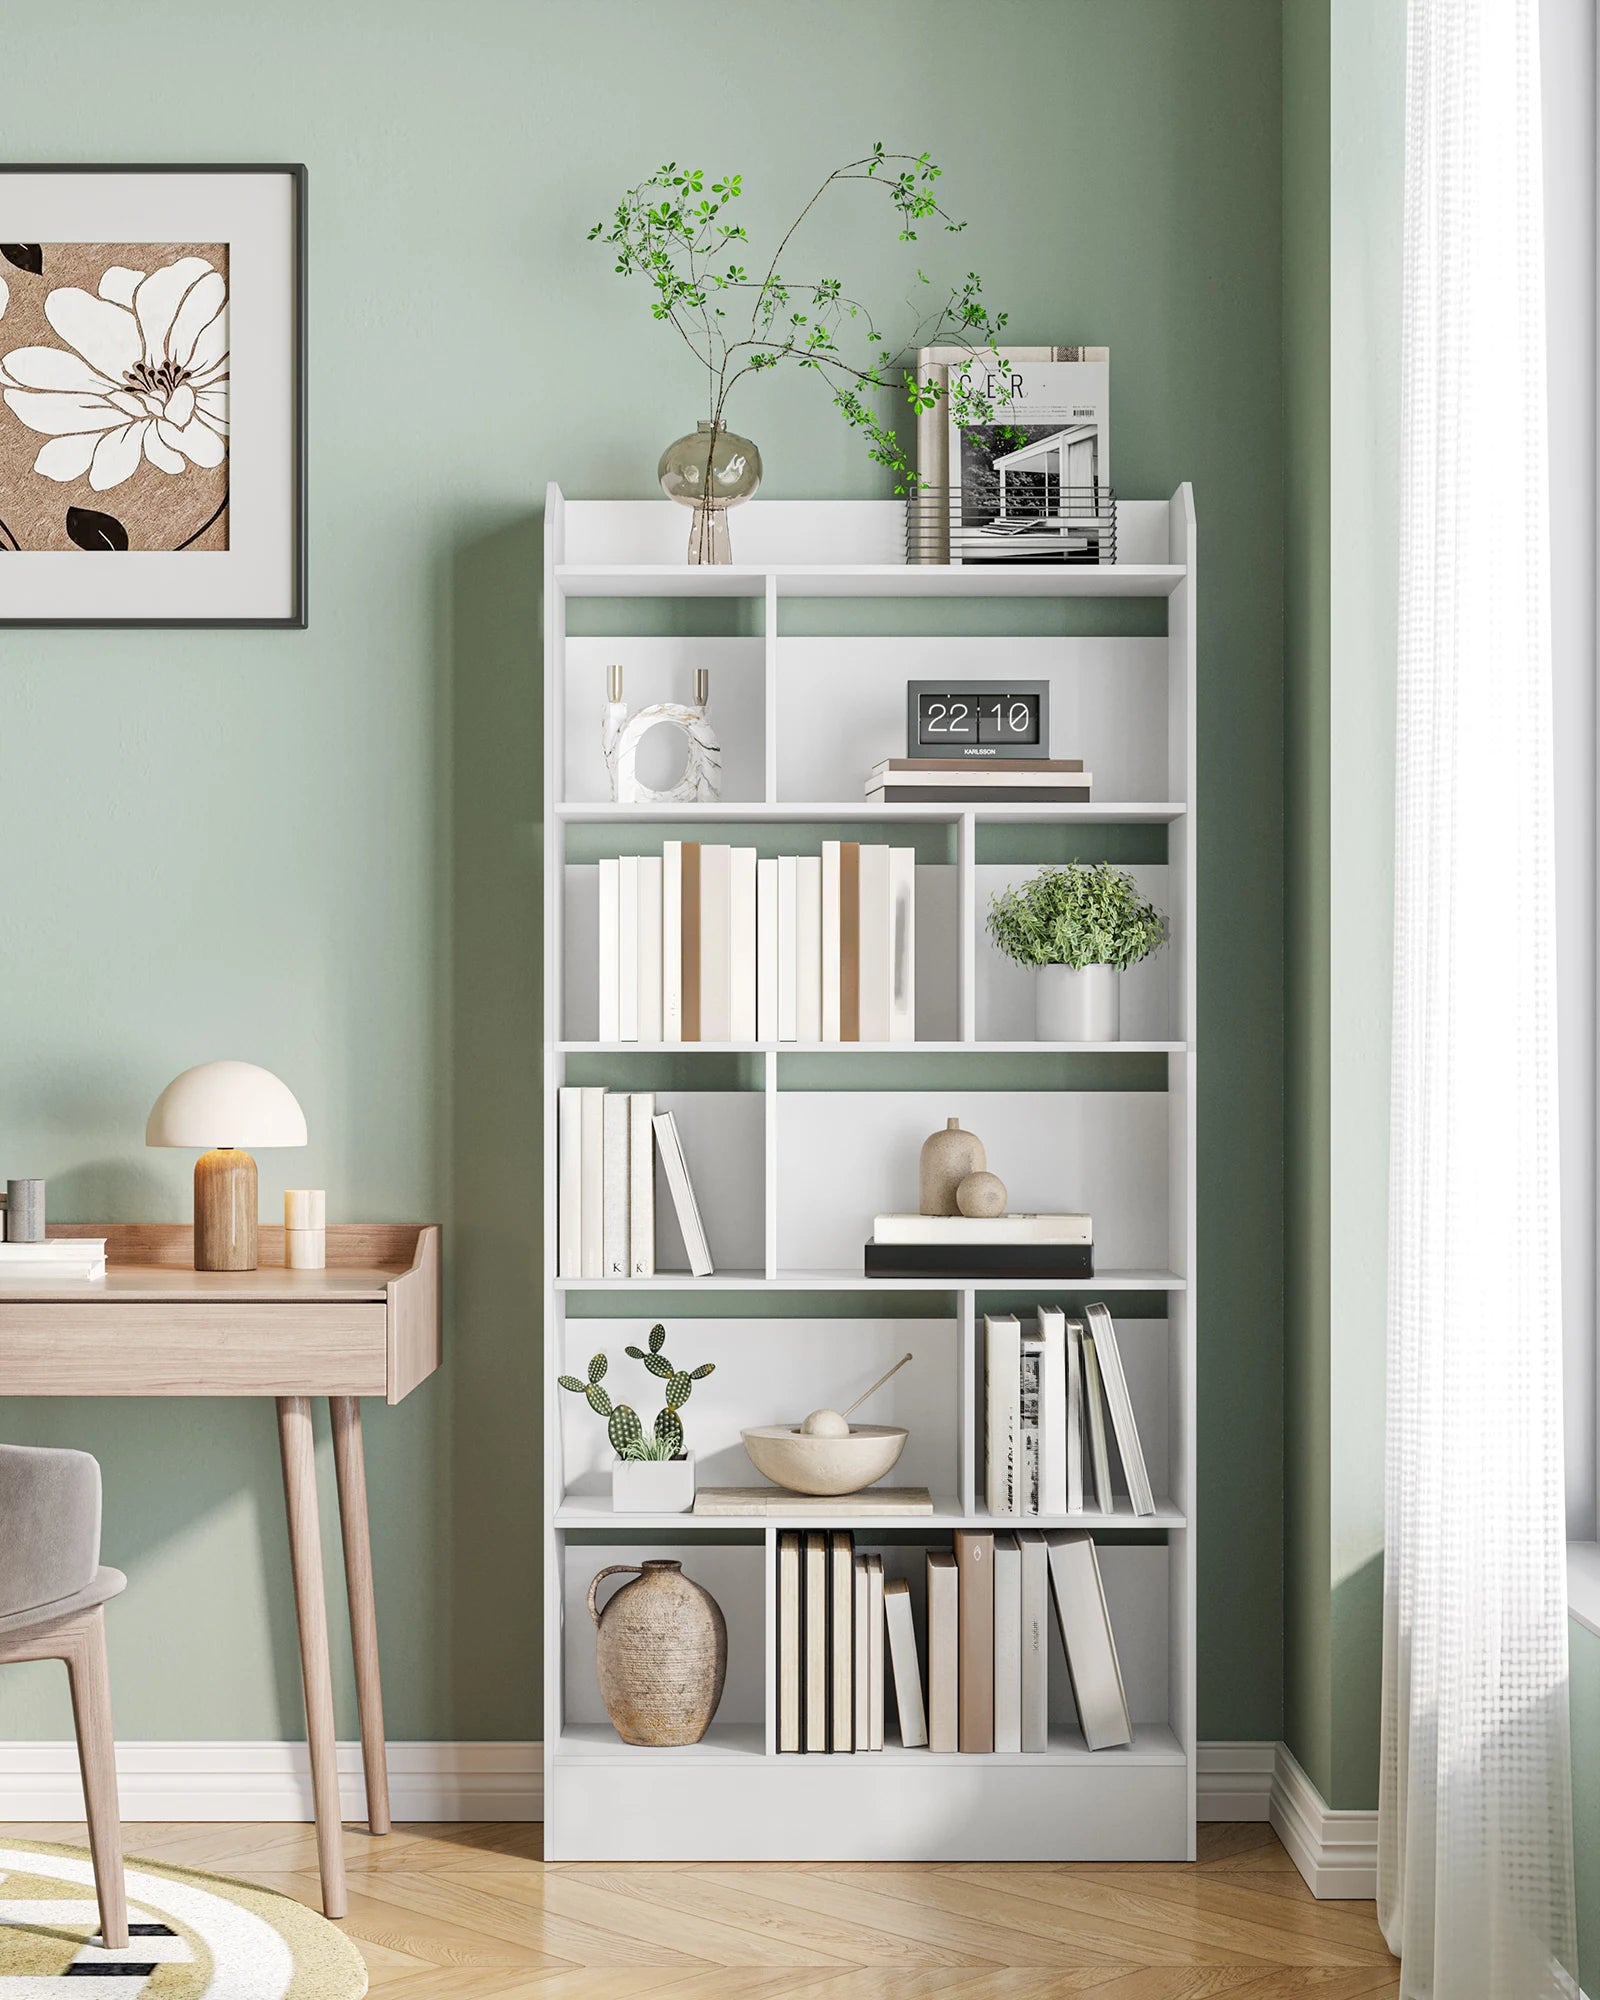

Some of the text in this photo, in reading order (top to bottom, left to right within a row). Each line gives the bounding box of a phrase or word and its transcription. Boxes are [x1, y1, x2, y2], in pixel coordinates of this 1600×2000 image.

[928, 702, 1030, 732] 22 10
[613, 1262, 622, 1273] K
[636, 1263, 643, 1273] K
